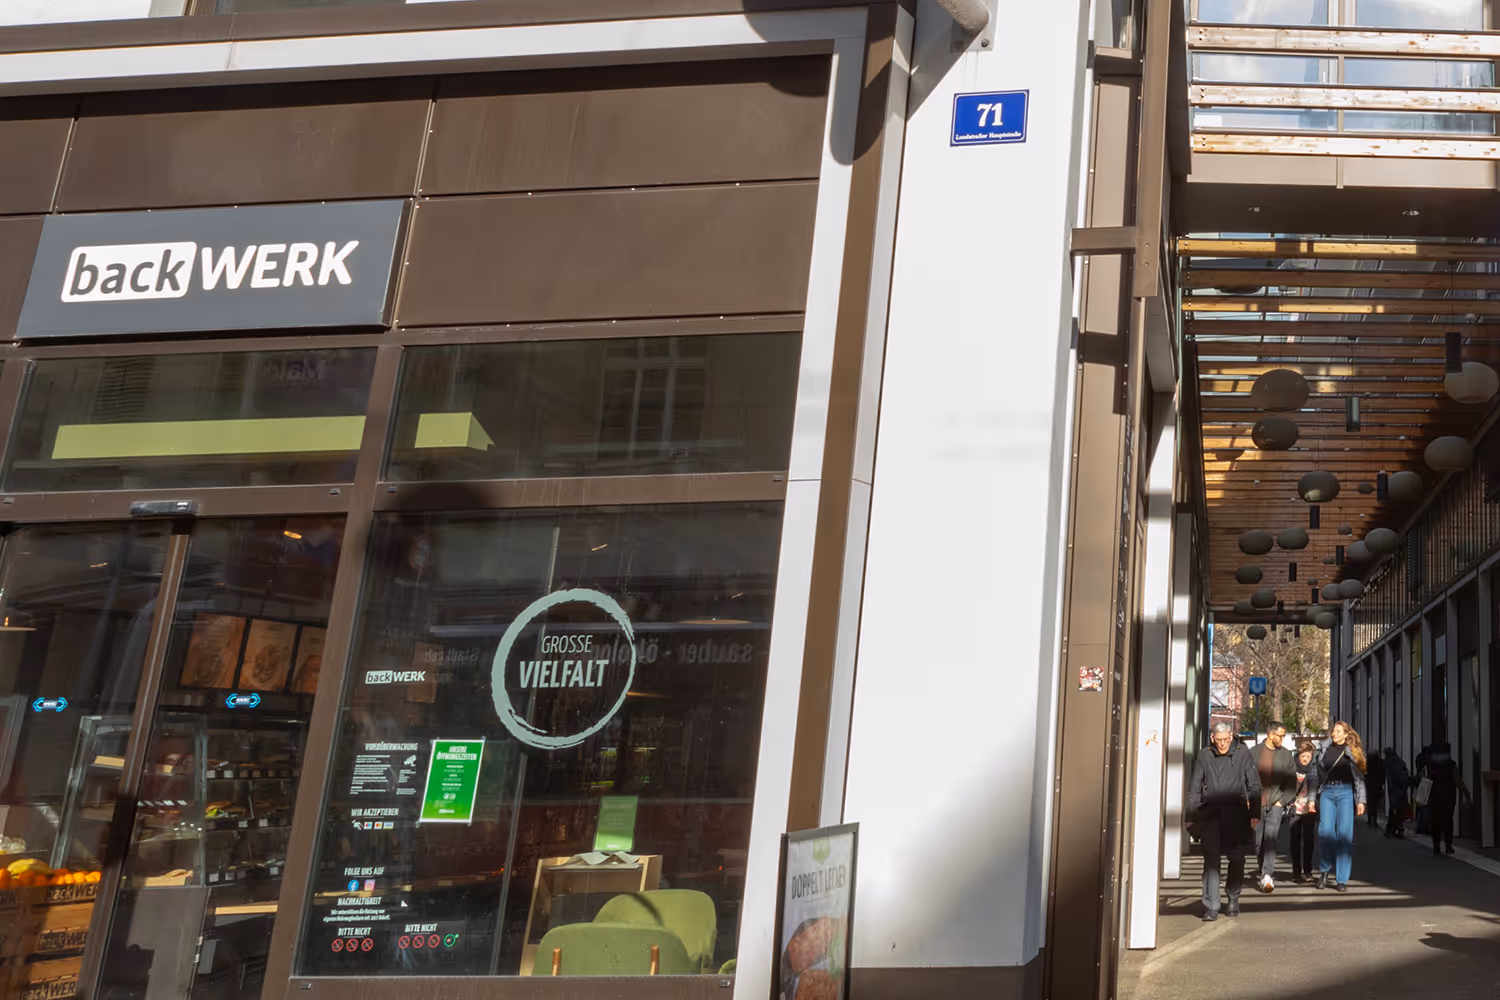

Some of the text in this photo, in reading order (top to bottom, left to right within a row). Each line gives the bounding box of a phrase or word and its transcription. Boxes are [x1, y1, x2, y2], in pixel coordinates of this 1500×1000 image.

[977, 102, 1003, 127] 71
[541, 634, 594, 655] GROSSE
[366, 670, 426, 684] backWERK
[519, 659, 610, 689] VIELFALT
[1252, 680, 1263, 694] U
[365, 742, 418, 751] VIDEOÜBERWACHUNG
[351, 808, 399, 817] WIR AKZEPTIEREN
[344, 866, 385, 876] FOLGE UNS AUF
[792, 865, 846, 900] DOPPELT LECKER
[337, 897, 382, 906] NACHHALTIGKEIT
[338, 927, 372, 937] BITTE NICHT
[405, 923, 438, 933] BITTE NICHT
